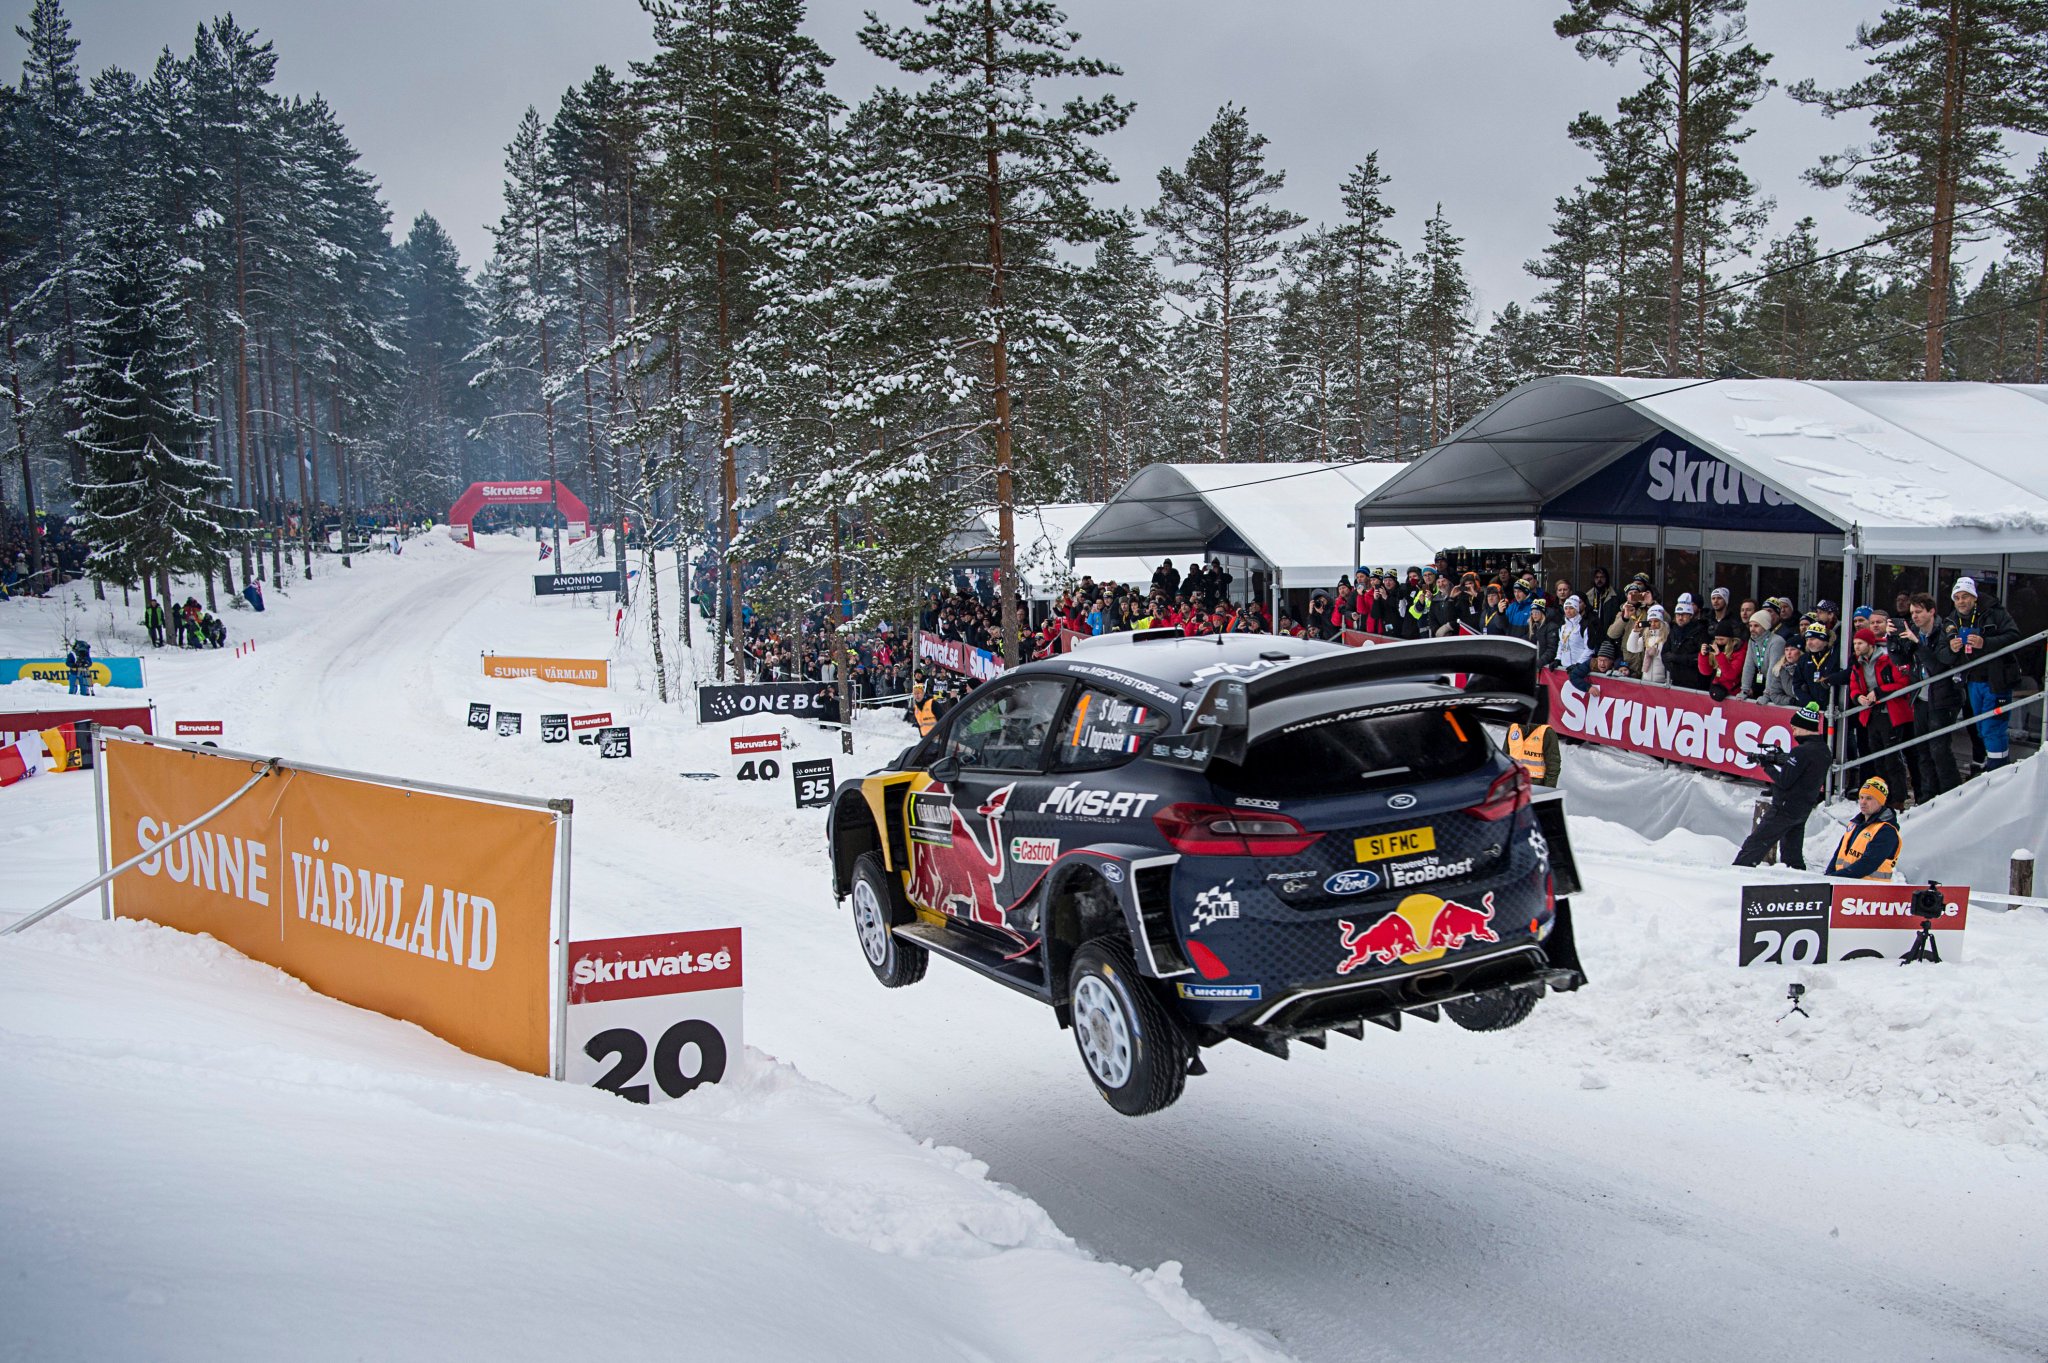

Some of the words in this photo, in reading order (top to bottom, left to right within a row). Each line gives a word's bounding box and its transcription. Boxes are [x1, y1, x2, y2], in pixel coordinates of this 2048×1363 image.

[482, 486, 543, 496] Skruvat.se
[553, 575, 602, 586] ANONIMO
[494, 667, 537, 677] SUNNE
[544, 666, 598, 680] VÄRMLAND
[1068, 664, 1178, 704] www.MSPORTSTORE.com
[470, 712, 489, 724] 60
[1099, 699, 1110, 721] S
[1282, 697, 1518, 733] www.MSPORTSTORE.com
[499, 723, 519, 734] 55
[573, 717, 610, 727] Skruvat.se
[1071, 694, 1093, 747] 1
[543, 726, 567, 741] 50
[1081, 725, 1091, 747] J
[604, 741, 627, 757] 45
[733, 739, 779, 750] Skruvat.se
[736, 759, 780, 781] 40
[804, 765, 831, 774] ONEBET
[800, 778, 830, 801] 35
[1235, 797, 1280, 809] sparco
[1075, 815, 1121, 824] TECHNOLOGY
[1021, 840, 1057, 861] Castrol
[1389, 834, 1420, 853] FMC
[1390, 859, 1428, 872] Powered
[1428, 855, 1440, 868] by
[1393, 858, 1473, 887] EcoBoost
[1332, 872, 1370, 892] Ford
[137, 815, 270, 907] SUNNE
[291, 836, 498, 971] VÄRMLAND
[1766, 900, 1824, 914] ONEBET
[1746, 929, 1821, 966] 20
[573, 950, 732, 985] Skruvat.se
[1194, 989, 1253, 997] MICHELIN
[583, 1019, 728, 1106] 20
